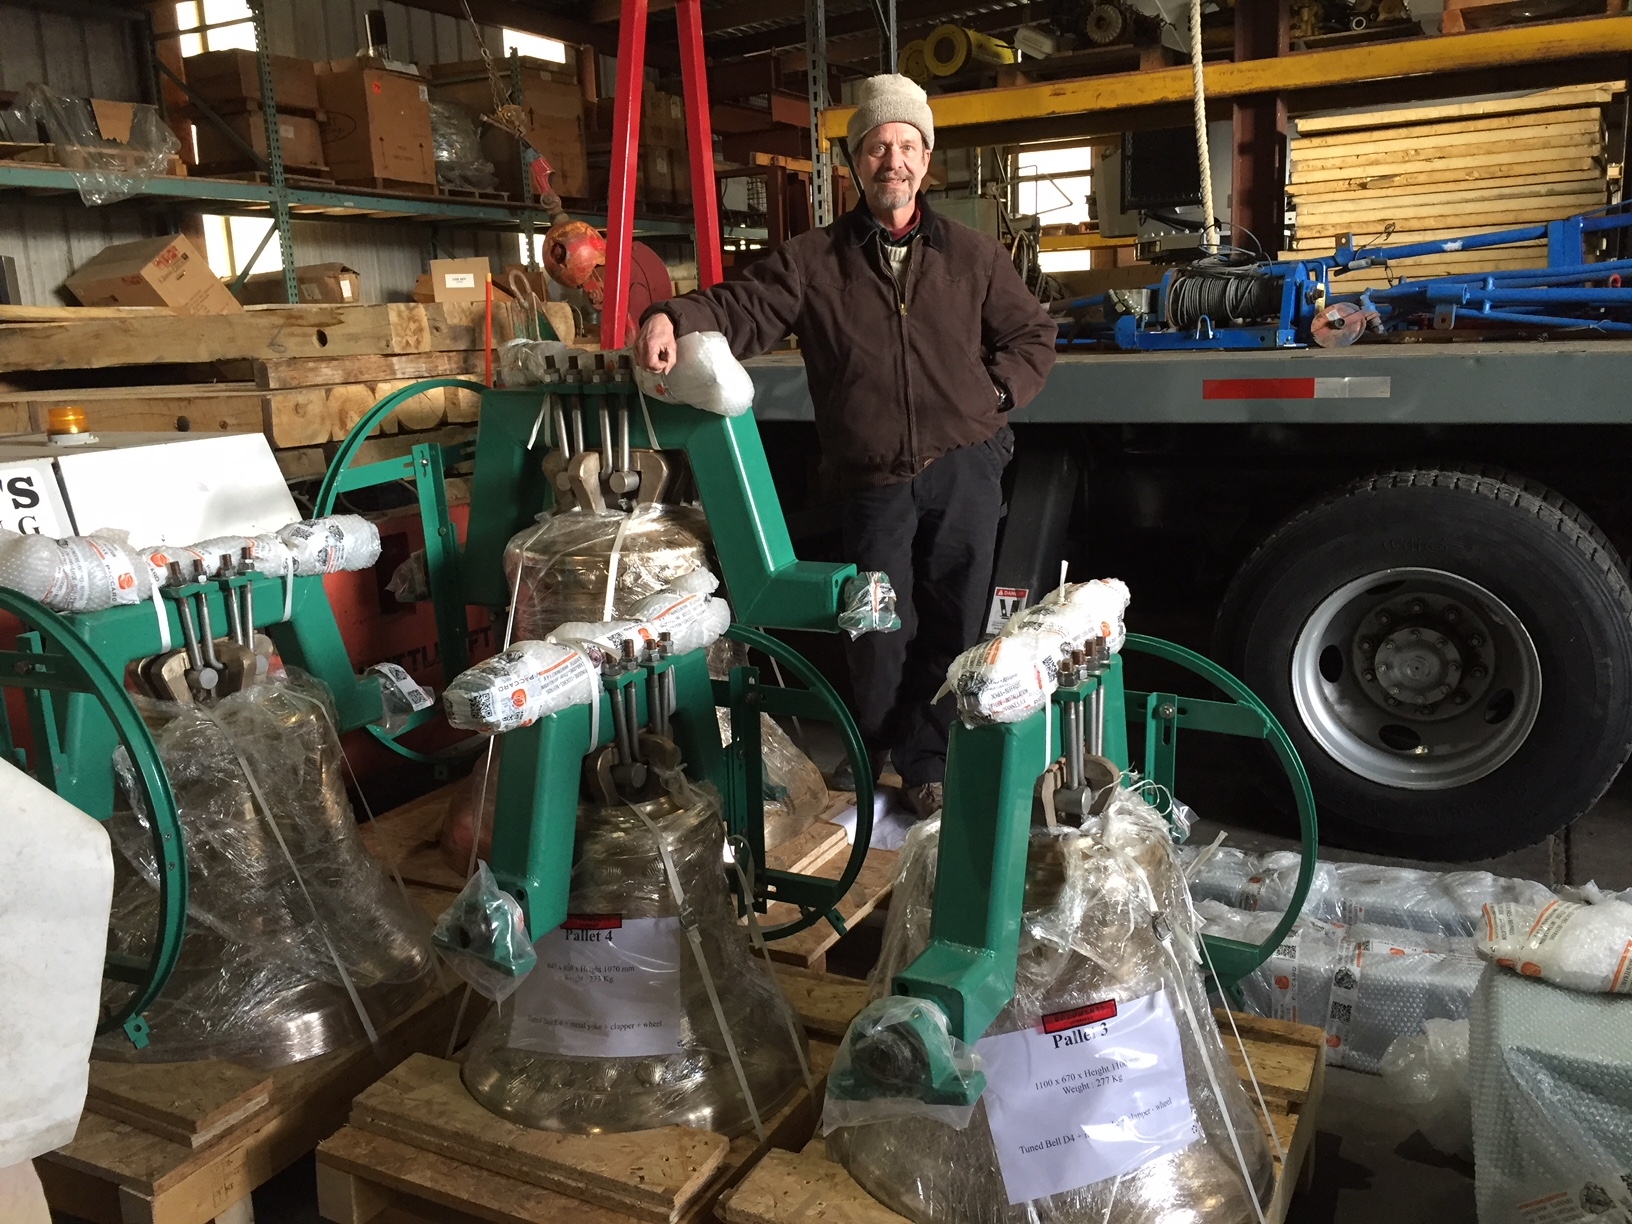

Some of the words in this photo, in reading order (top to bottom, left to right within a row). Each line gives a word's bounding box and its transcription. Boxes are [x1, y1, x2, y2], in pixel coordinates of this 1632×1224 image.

[498, 674, 535, 692] PACCARD
[565, 929, 601, 942] Pallet
[604, 930, 613, 942] 4
[610, 1022, 635, 1031] clapper
[643, 1020, 662, 1028] wheel
[1099, 1022, 1109, 1037] 3
[1035, 1078, 1054, 1091] 1100
[1061, 1073, 1076, 1084] 670
[1084, 1065, 1110, 1078] Height
[1062, 1083, 1090, 1095] Weight
[1096, 1075, 1110, 1087] 277
[1111, 1074, 1124, 1083] Kg
[1019, 1141, 1044, 1155] Tuned
[1045, 1136, 1062, 1149] Bell
[1062, 1134, 1075, 1145] D4
[1155, 1096, 1173, 1111] wheel
